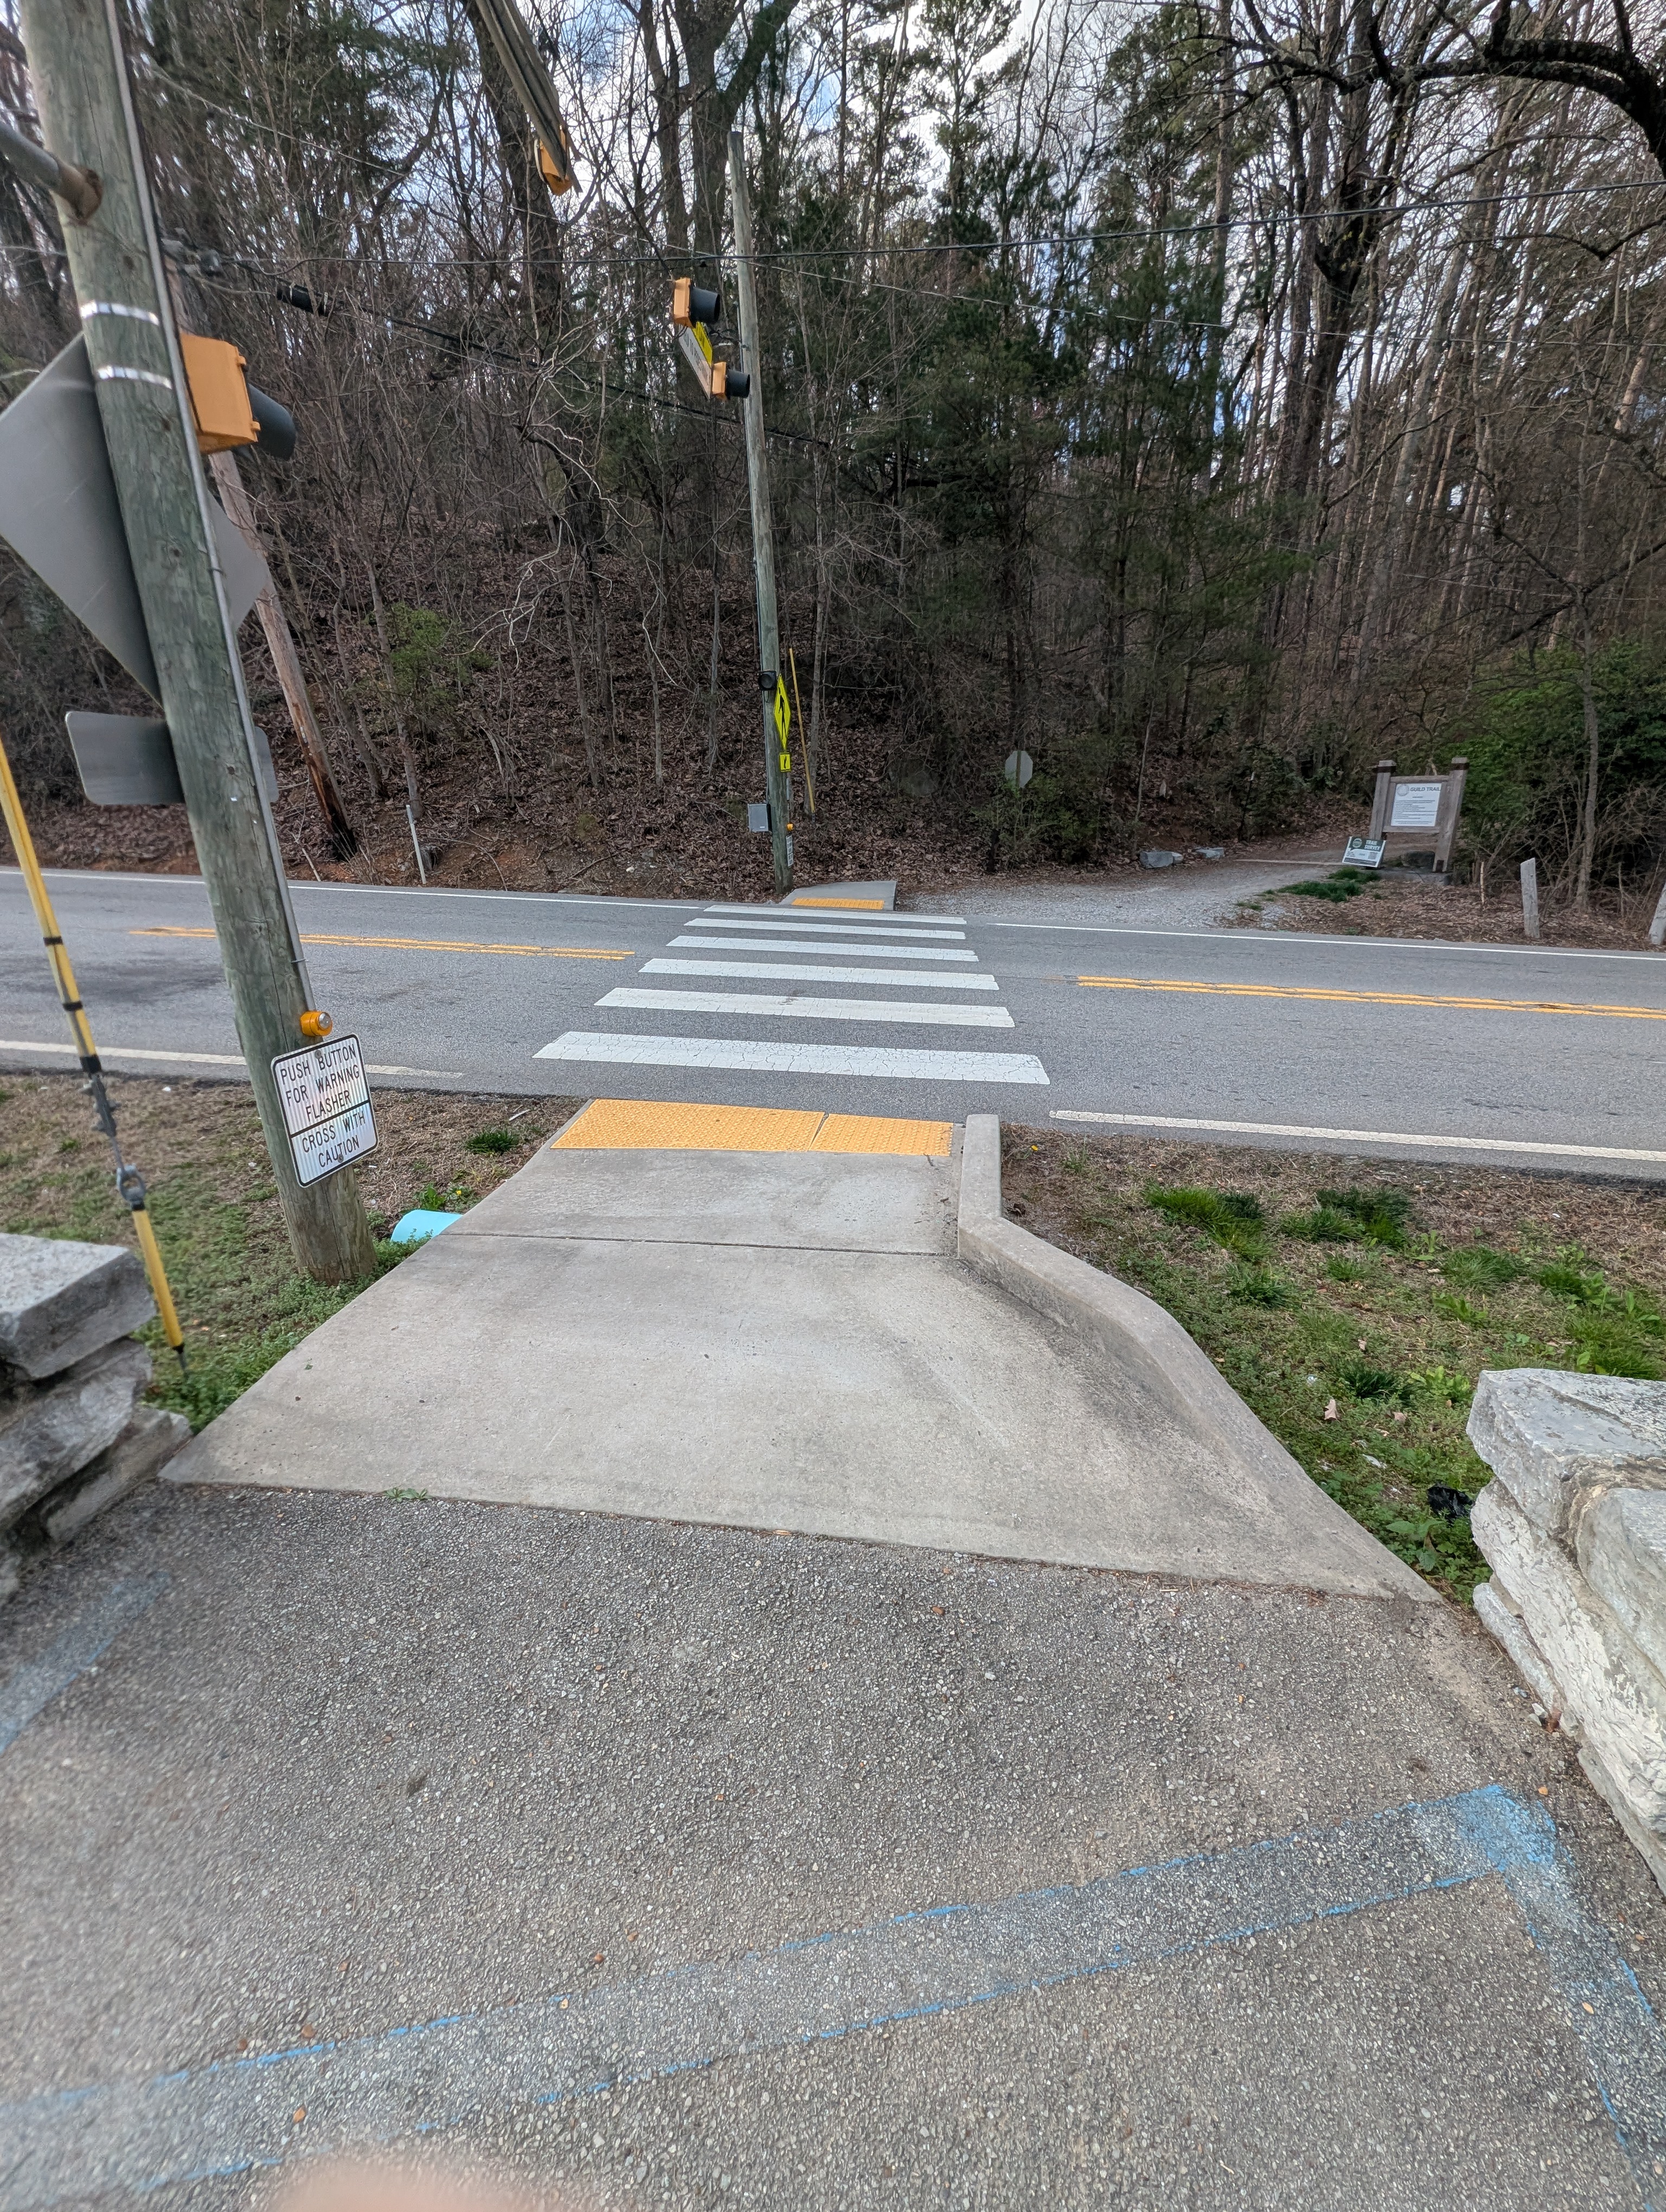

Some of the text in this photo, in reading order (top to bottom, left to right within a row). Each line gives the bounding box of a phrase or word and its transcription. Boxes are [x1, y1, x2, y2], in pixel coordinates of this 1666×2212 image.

[280, 1044, 356, 1085] PUSH BUTTON
[286, 1065, 359, 1106] FOR WARNING
[306, 1090, 351, 1121] FLASHER
[302, 1111, 366, 1153] CROSS WITH
[319, 1135, 360, 1167] CAUTION
